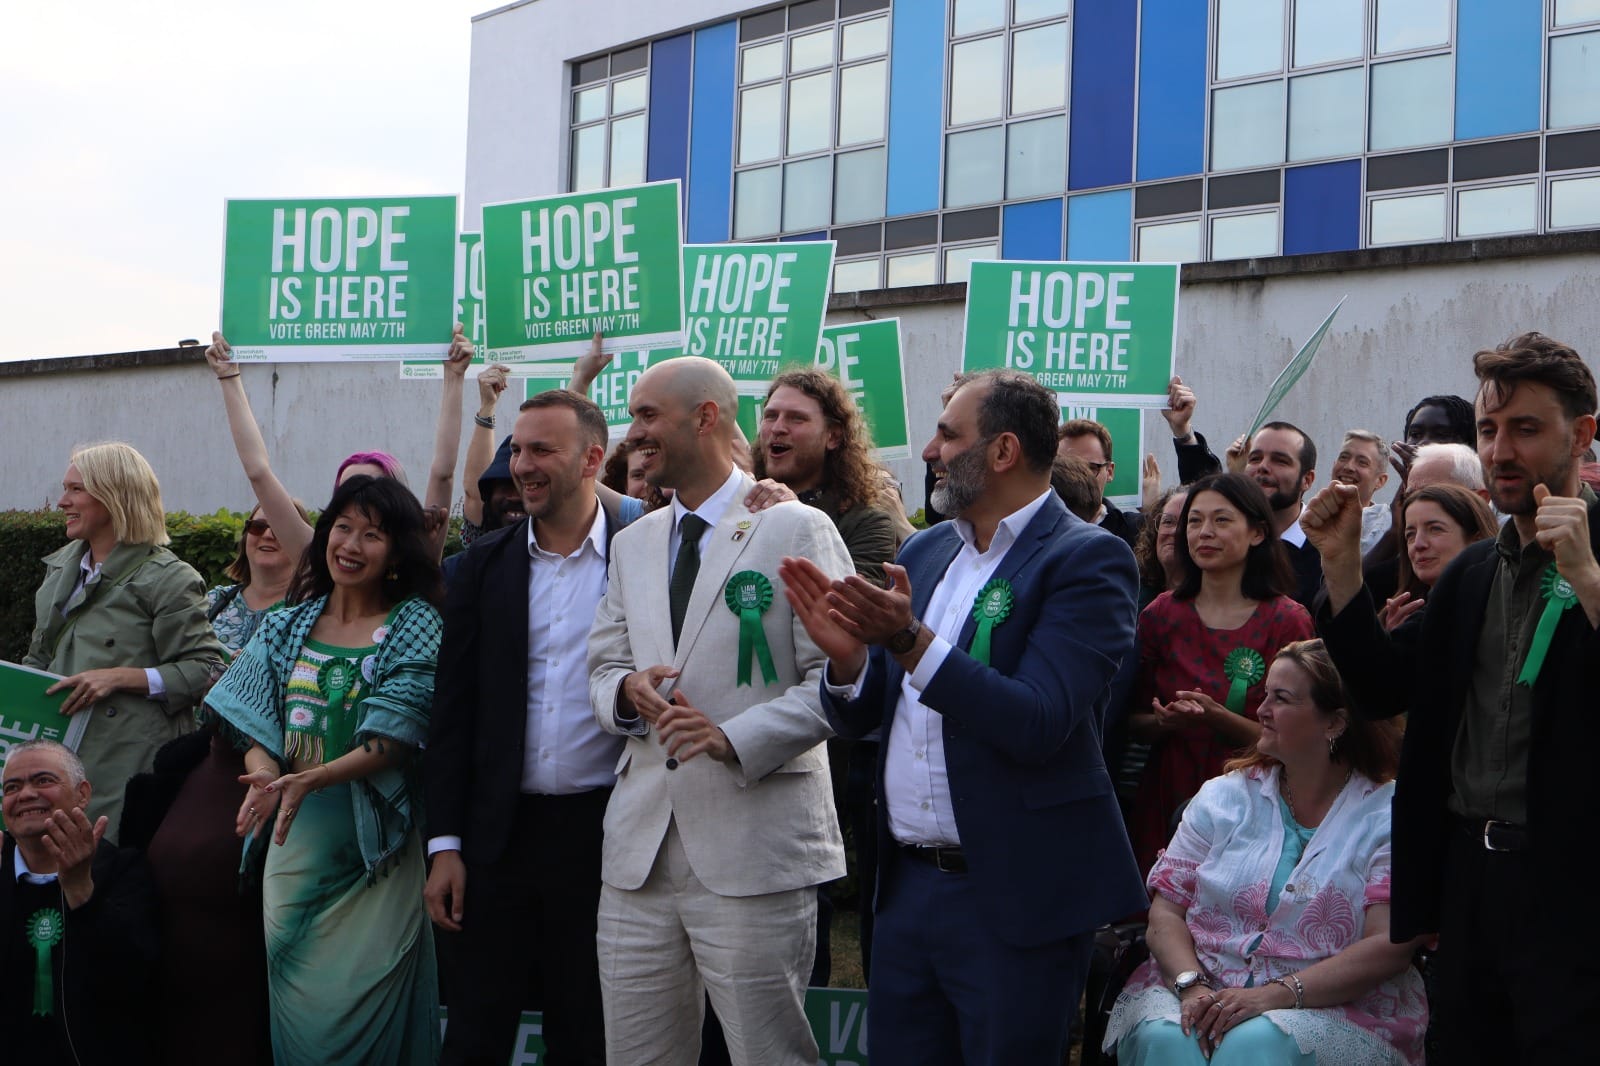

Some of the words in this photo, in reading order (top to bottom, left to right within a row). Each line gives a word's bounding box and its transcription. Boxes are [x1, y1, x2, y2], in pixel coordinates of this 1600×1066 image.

[272, 206, 410, 273] HOPE
[522, 197, 638, 274] HOPE
[269, 277, 302, 320] IS
[314, 275, 408, 319] HERE
[524, 276, 550, 320] IS
[561, 266, 640, 316] HERE
[690, 252, 797, 313] HOPE
[1008, 270, 1134, 329] HOPE
[270, 324, 301, 339] VOTE
[305, 323, 346, 339] GREEN
[350, 322, 376, 338] MAY
[381, 322, 405, 338] 7TH
[525, 322, 551, 339] VOTE
[555, 318, 589, 336] GREEN
[593, 315, 615, 333] MAY
[619, 313, 640, 330] 7TH
[682, 317, 709, 355] IS
[714, 317, 786, 356] HERE
[738, 360, 758, 374] MAY
[760, 360, 778, 375] 7TH
[1006, 331, 1035, 369] IS
[1045, 332, 1130, 371] HERE
[592, 370, 641, 406] HER
[1037, 372, 1073, 387] GREEN
[1077, 373, 1101, 388] MAY
[1105, 374, 1127, 388] 7TH
